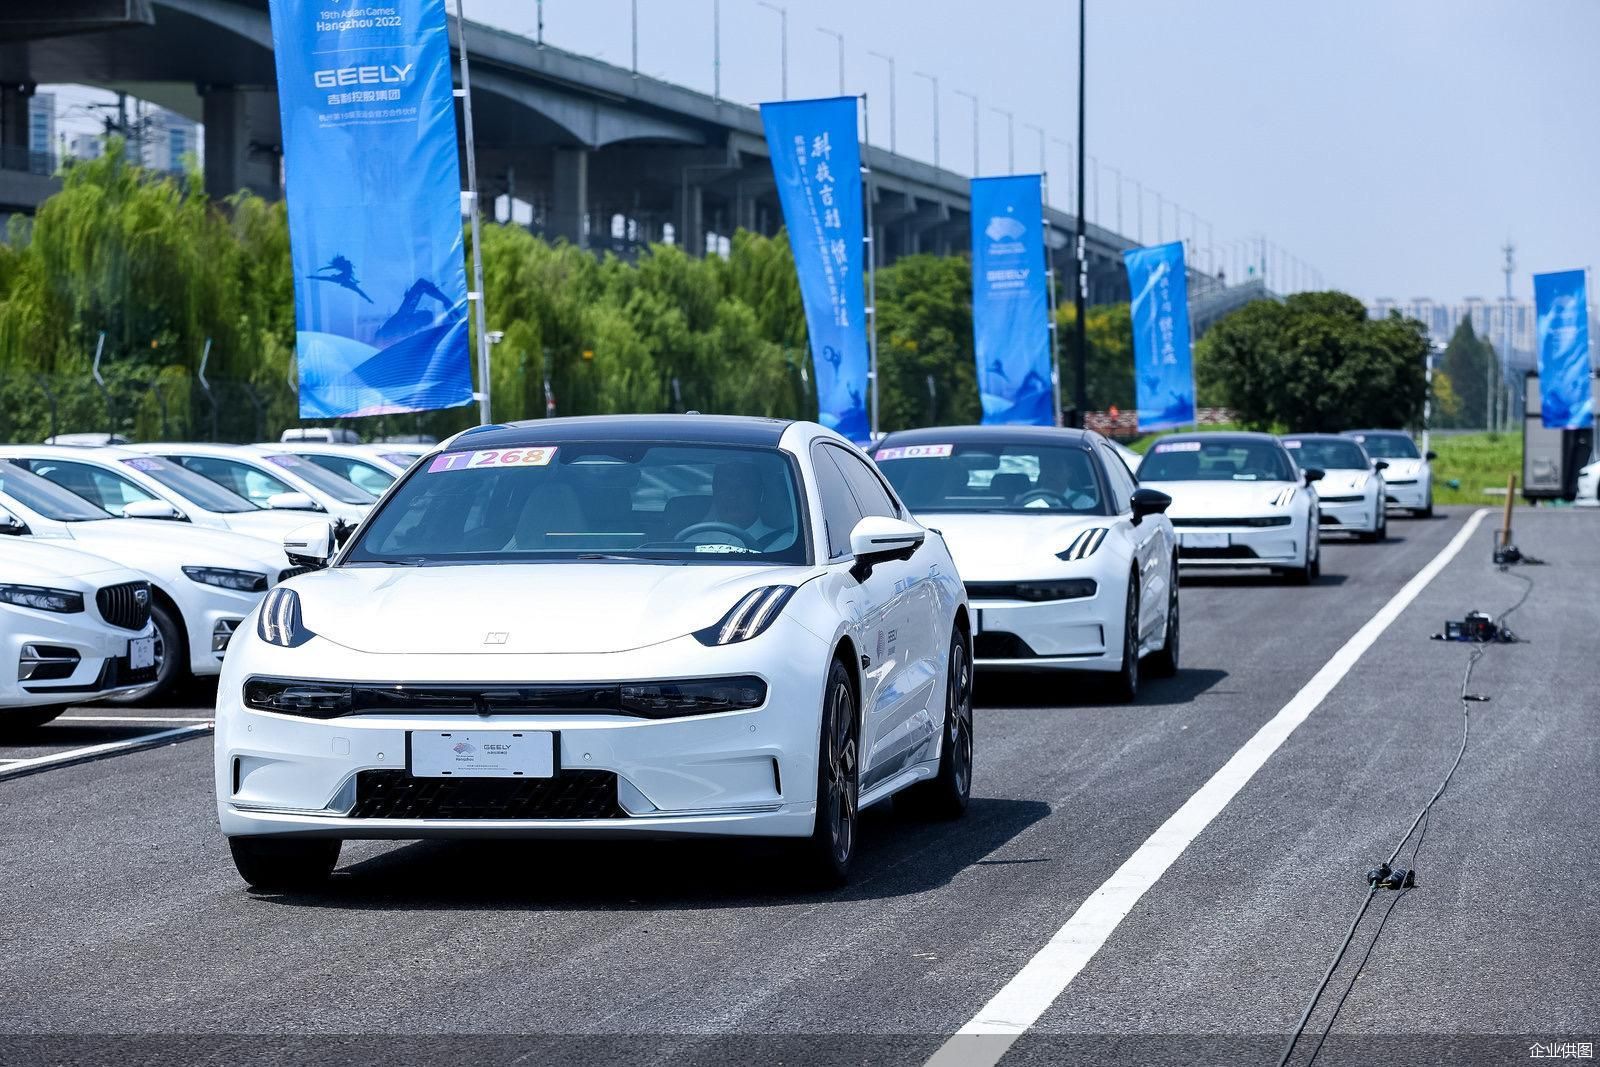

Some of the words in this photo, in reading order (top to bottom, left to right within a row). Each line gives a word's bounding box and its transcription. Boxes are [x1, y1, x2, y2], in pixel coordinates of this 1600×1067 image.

[320, 11, 340, 20] 19th
[341, 9, 366, 19] Asian
[366, 7, 396, 17] Games
[316, 19, 373, 32] Hangzhou
[374, 16, 402, 27] 2022
[314, 63, 413, 88] GEELY
[328, 89, 401, 105] 吉利控股集团
[444, 454, 466, 469] T
[476, 450, 544, 465] 268
